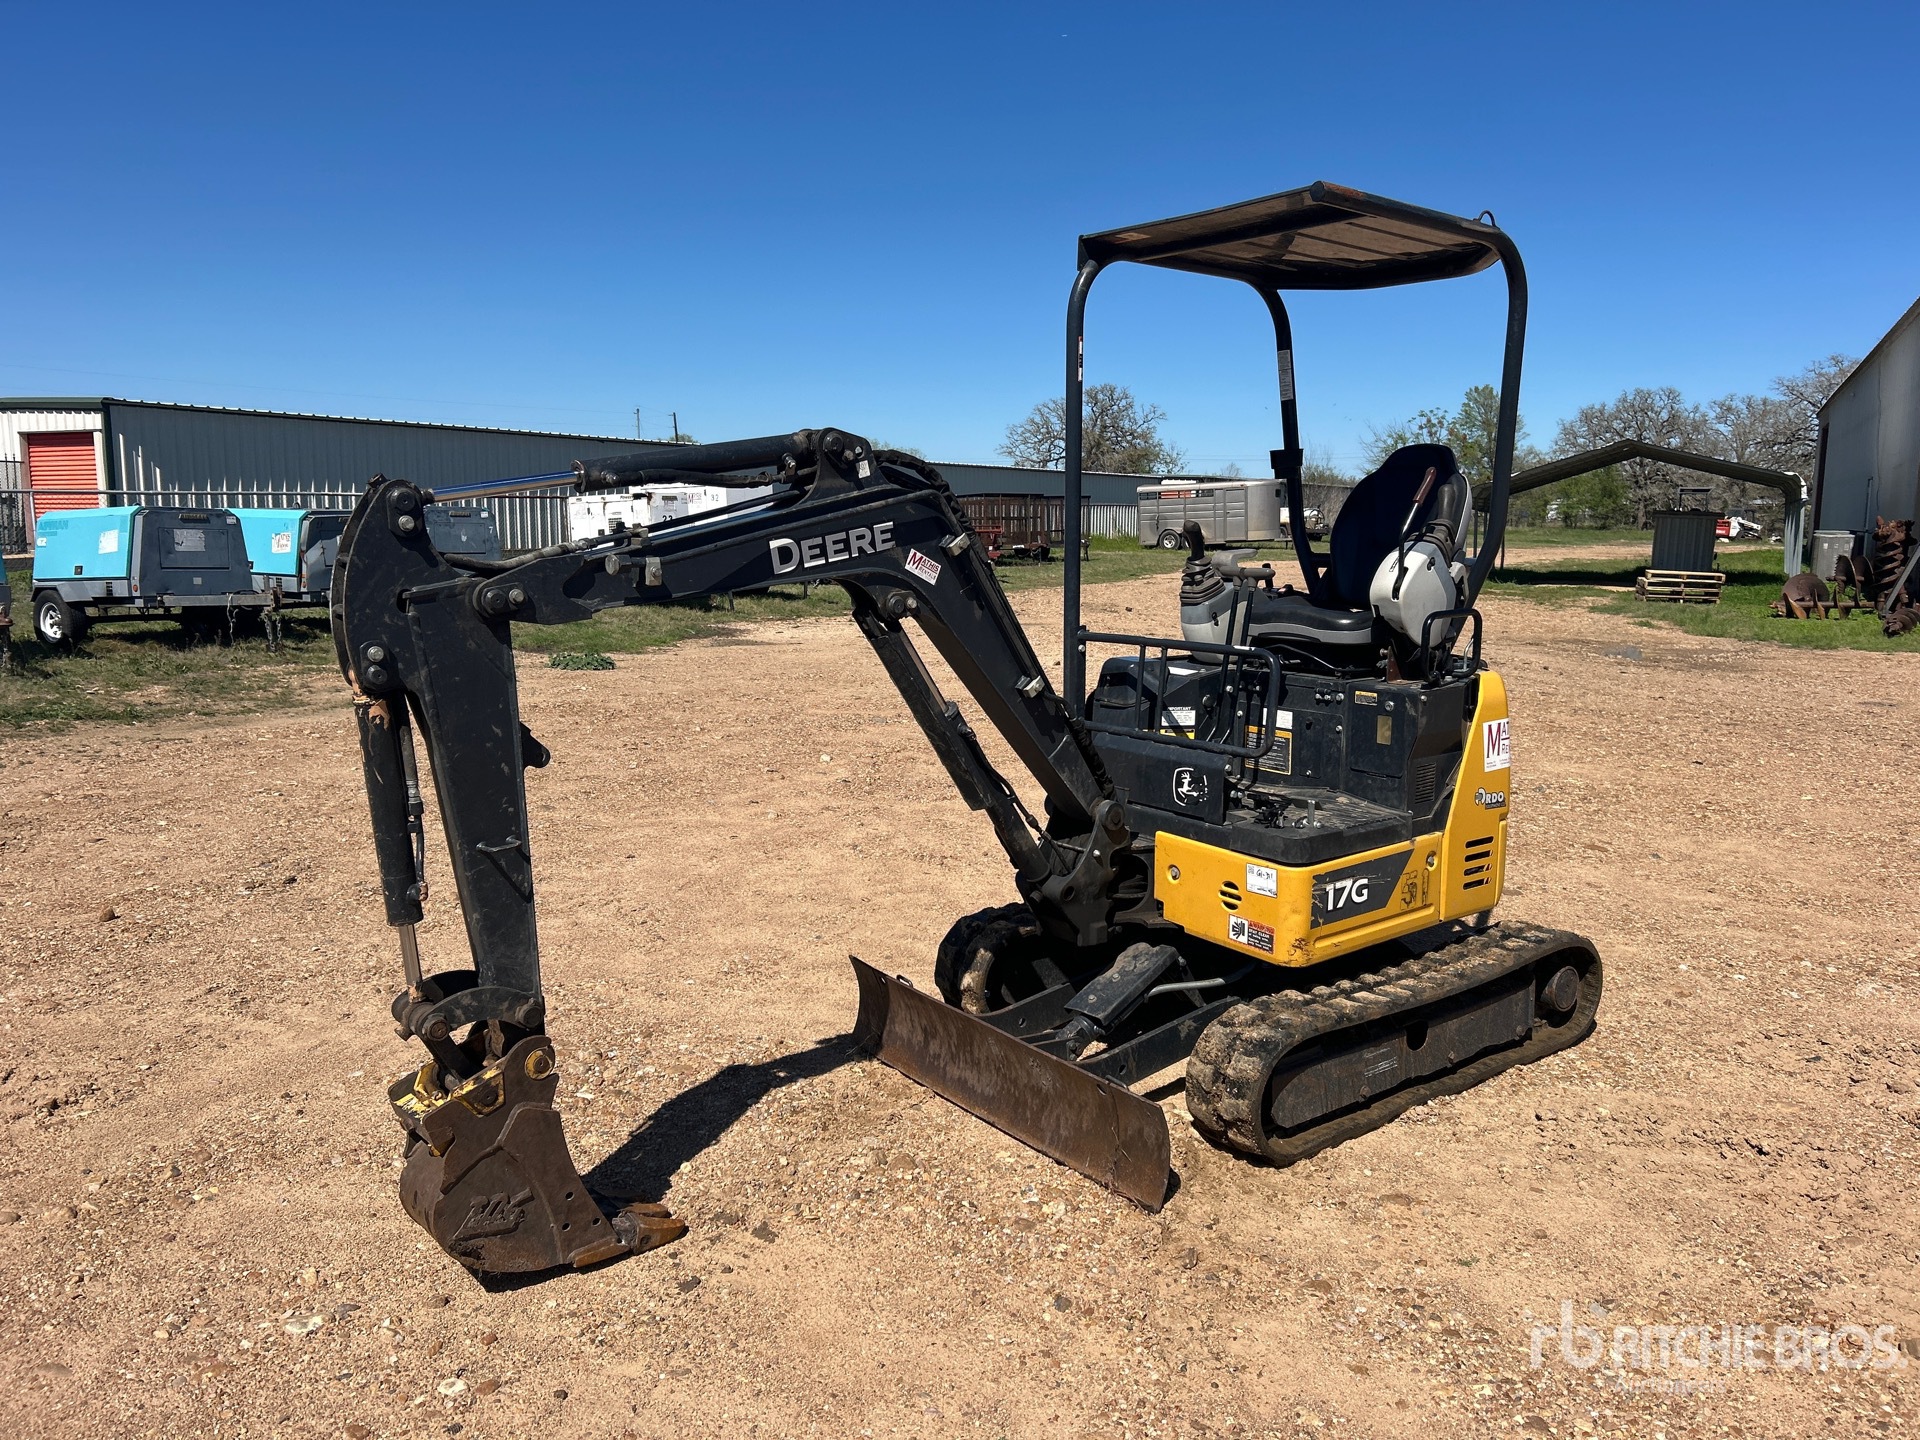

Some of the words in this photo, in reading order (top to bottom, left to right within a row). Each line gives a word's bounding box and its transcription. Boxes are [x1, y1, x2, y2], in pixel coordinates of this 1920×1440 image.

[769, 521, 896, 575] DEERE
[908, 551, 940, 572] MATHIS
[1325, 878, 1369, 912] 17G
